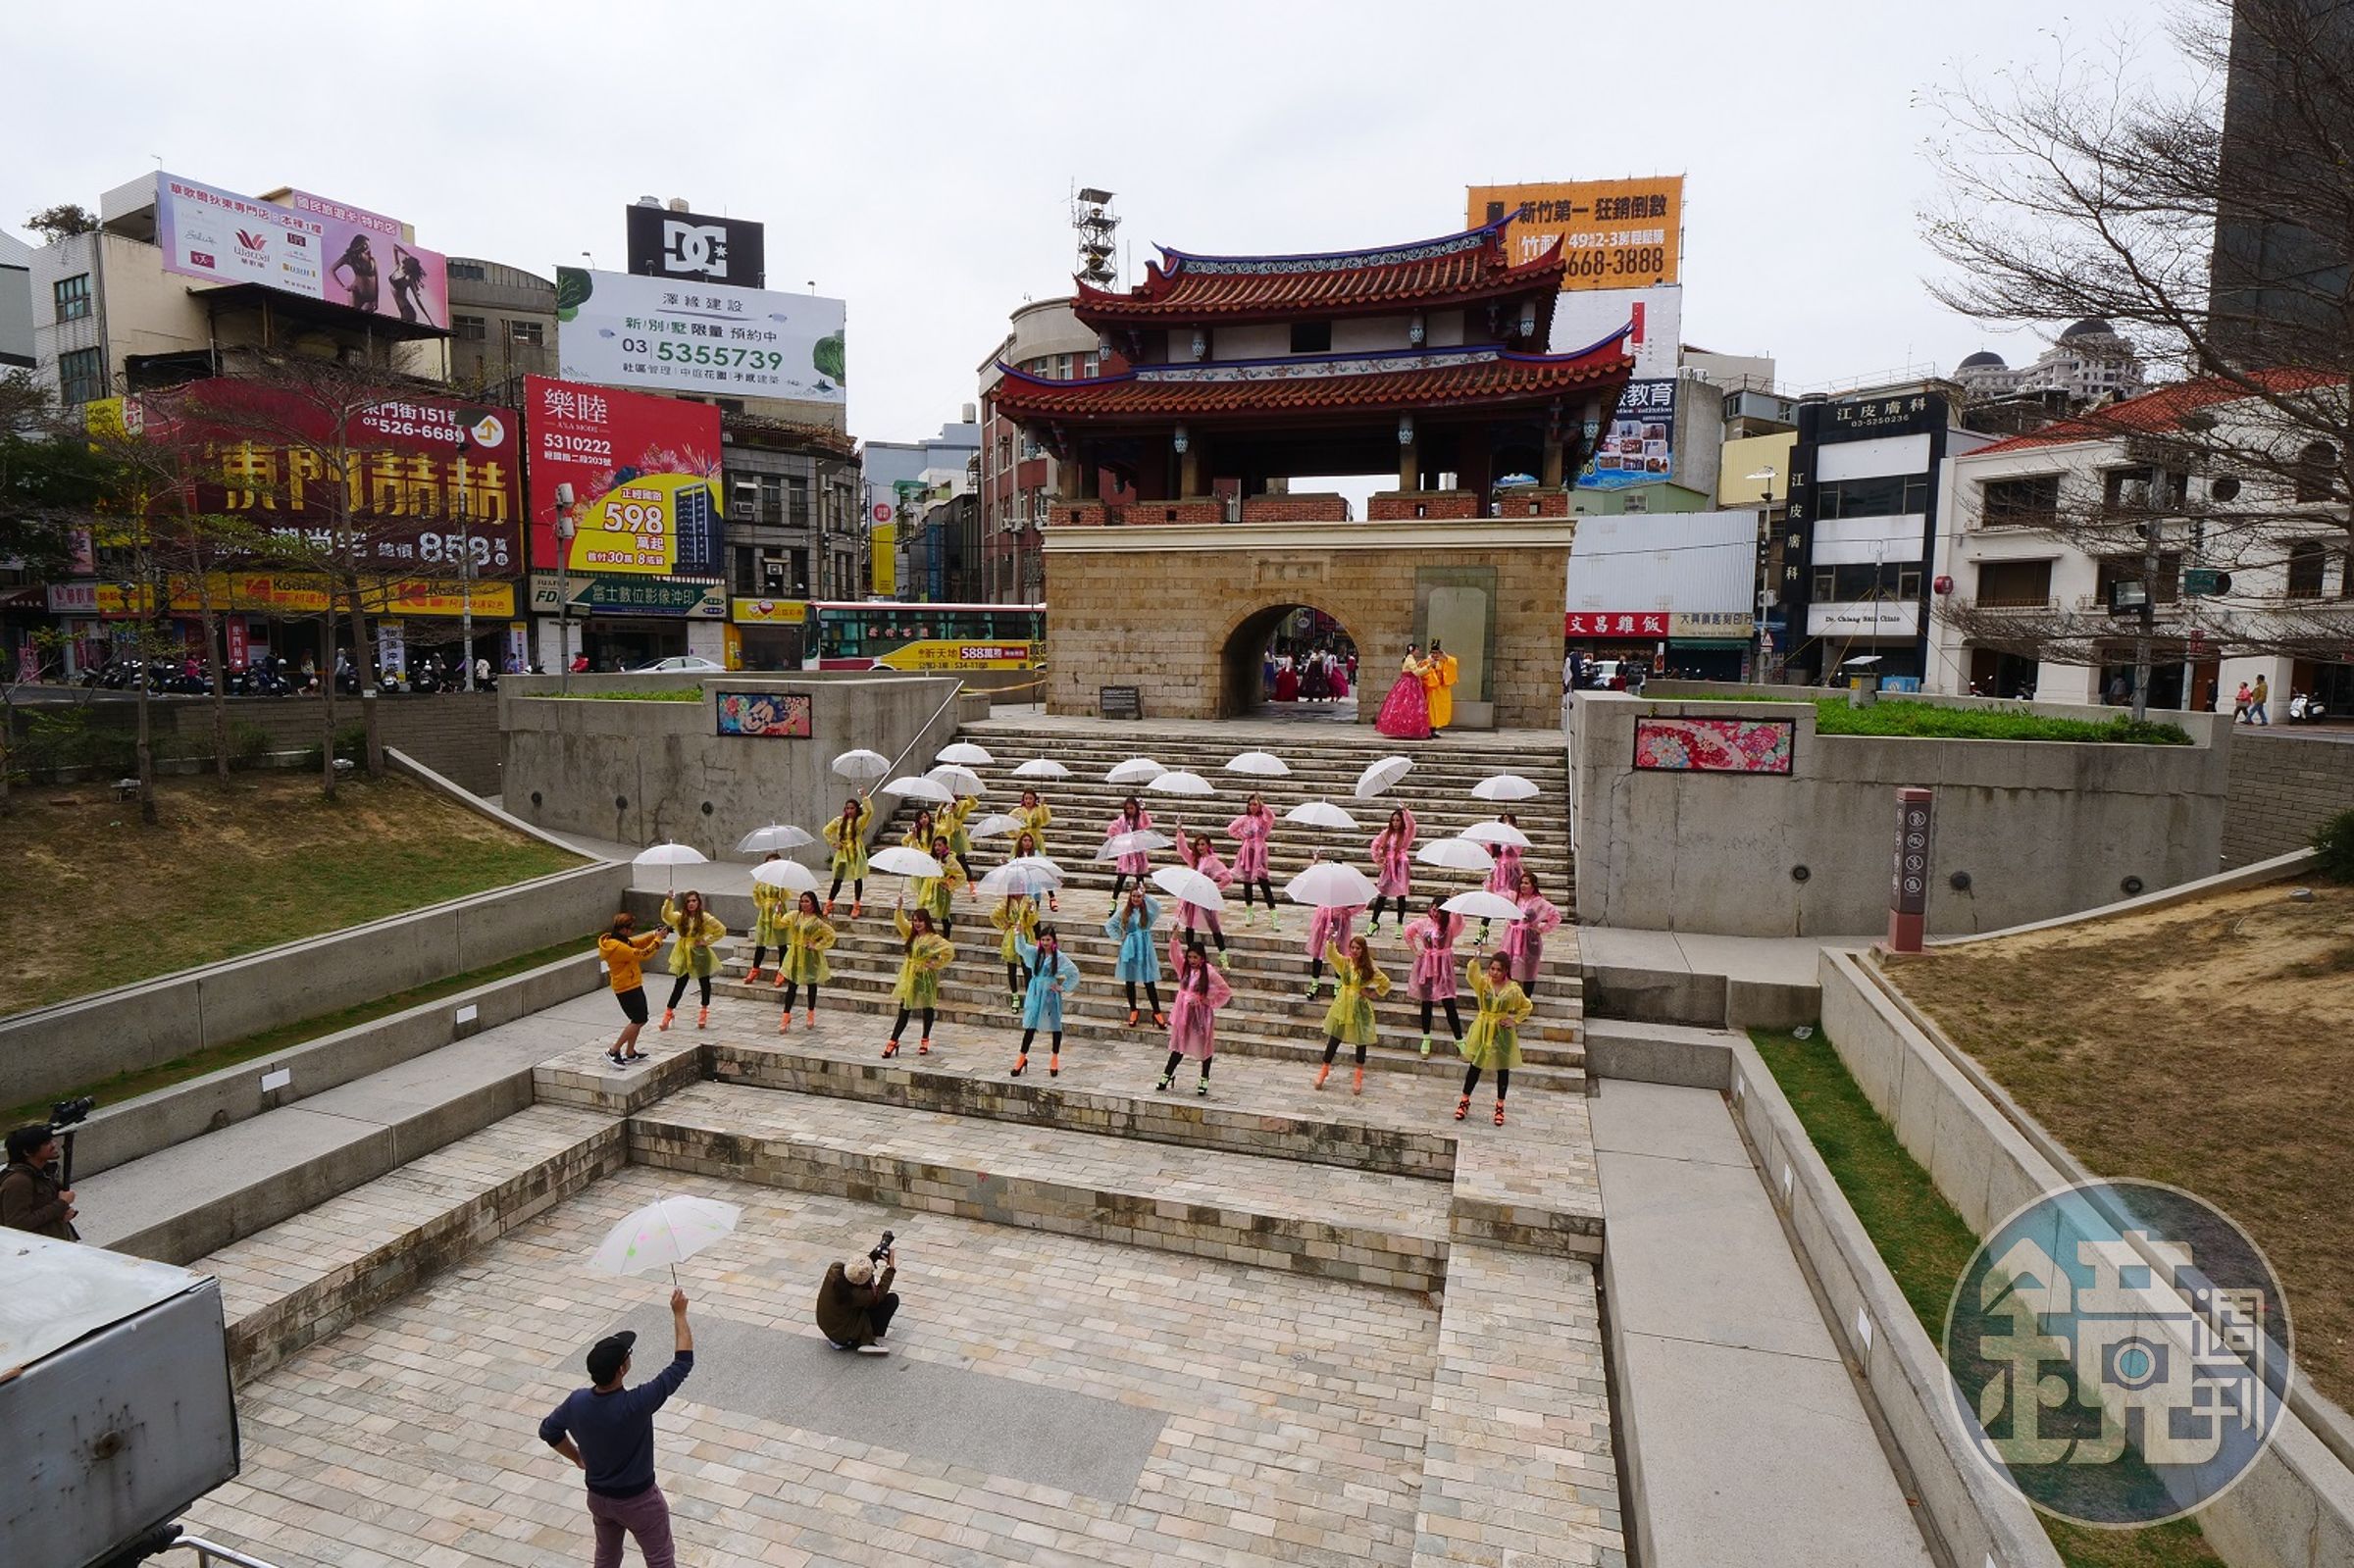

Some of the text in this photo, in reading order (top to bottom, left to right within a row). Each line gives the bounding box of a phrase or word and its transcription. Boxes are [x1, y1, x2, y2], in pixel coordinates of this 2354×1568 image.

[1519, 194, 1667, 224] 新竹第一 狂銷倒數
[664, 220, 727, 278] DC
[691, 324, 724, 338] 限量
[730, 327, 778, 342] 預約中
[622, 338, 783, 371] 03 5355739
[544, 387, 608, 425] 樂睦
[1836, 396, 1926, 422] 江皮膚科
[543, 433, 612, 455] 5310222
[603, 502, 664, 534] 598
[1785, 473, 1805, 581] 江皮膚科
[1568, 615, 1664, 634] 文昌雞飯
